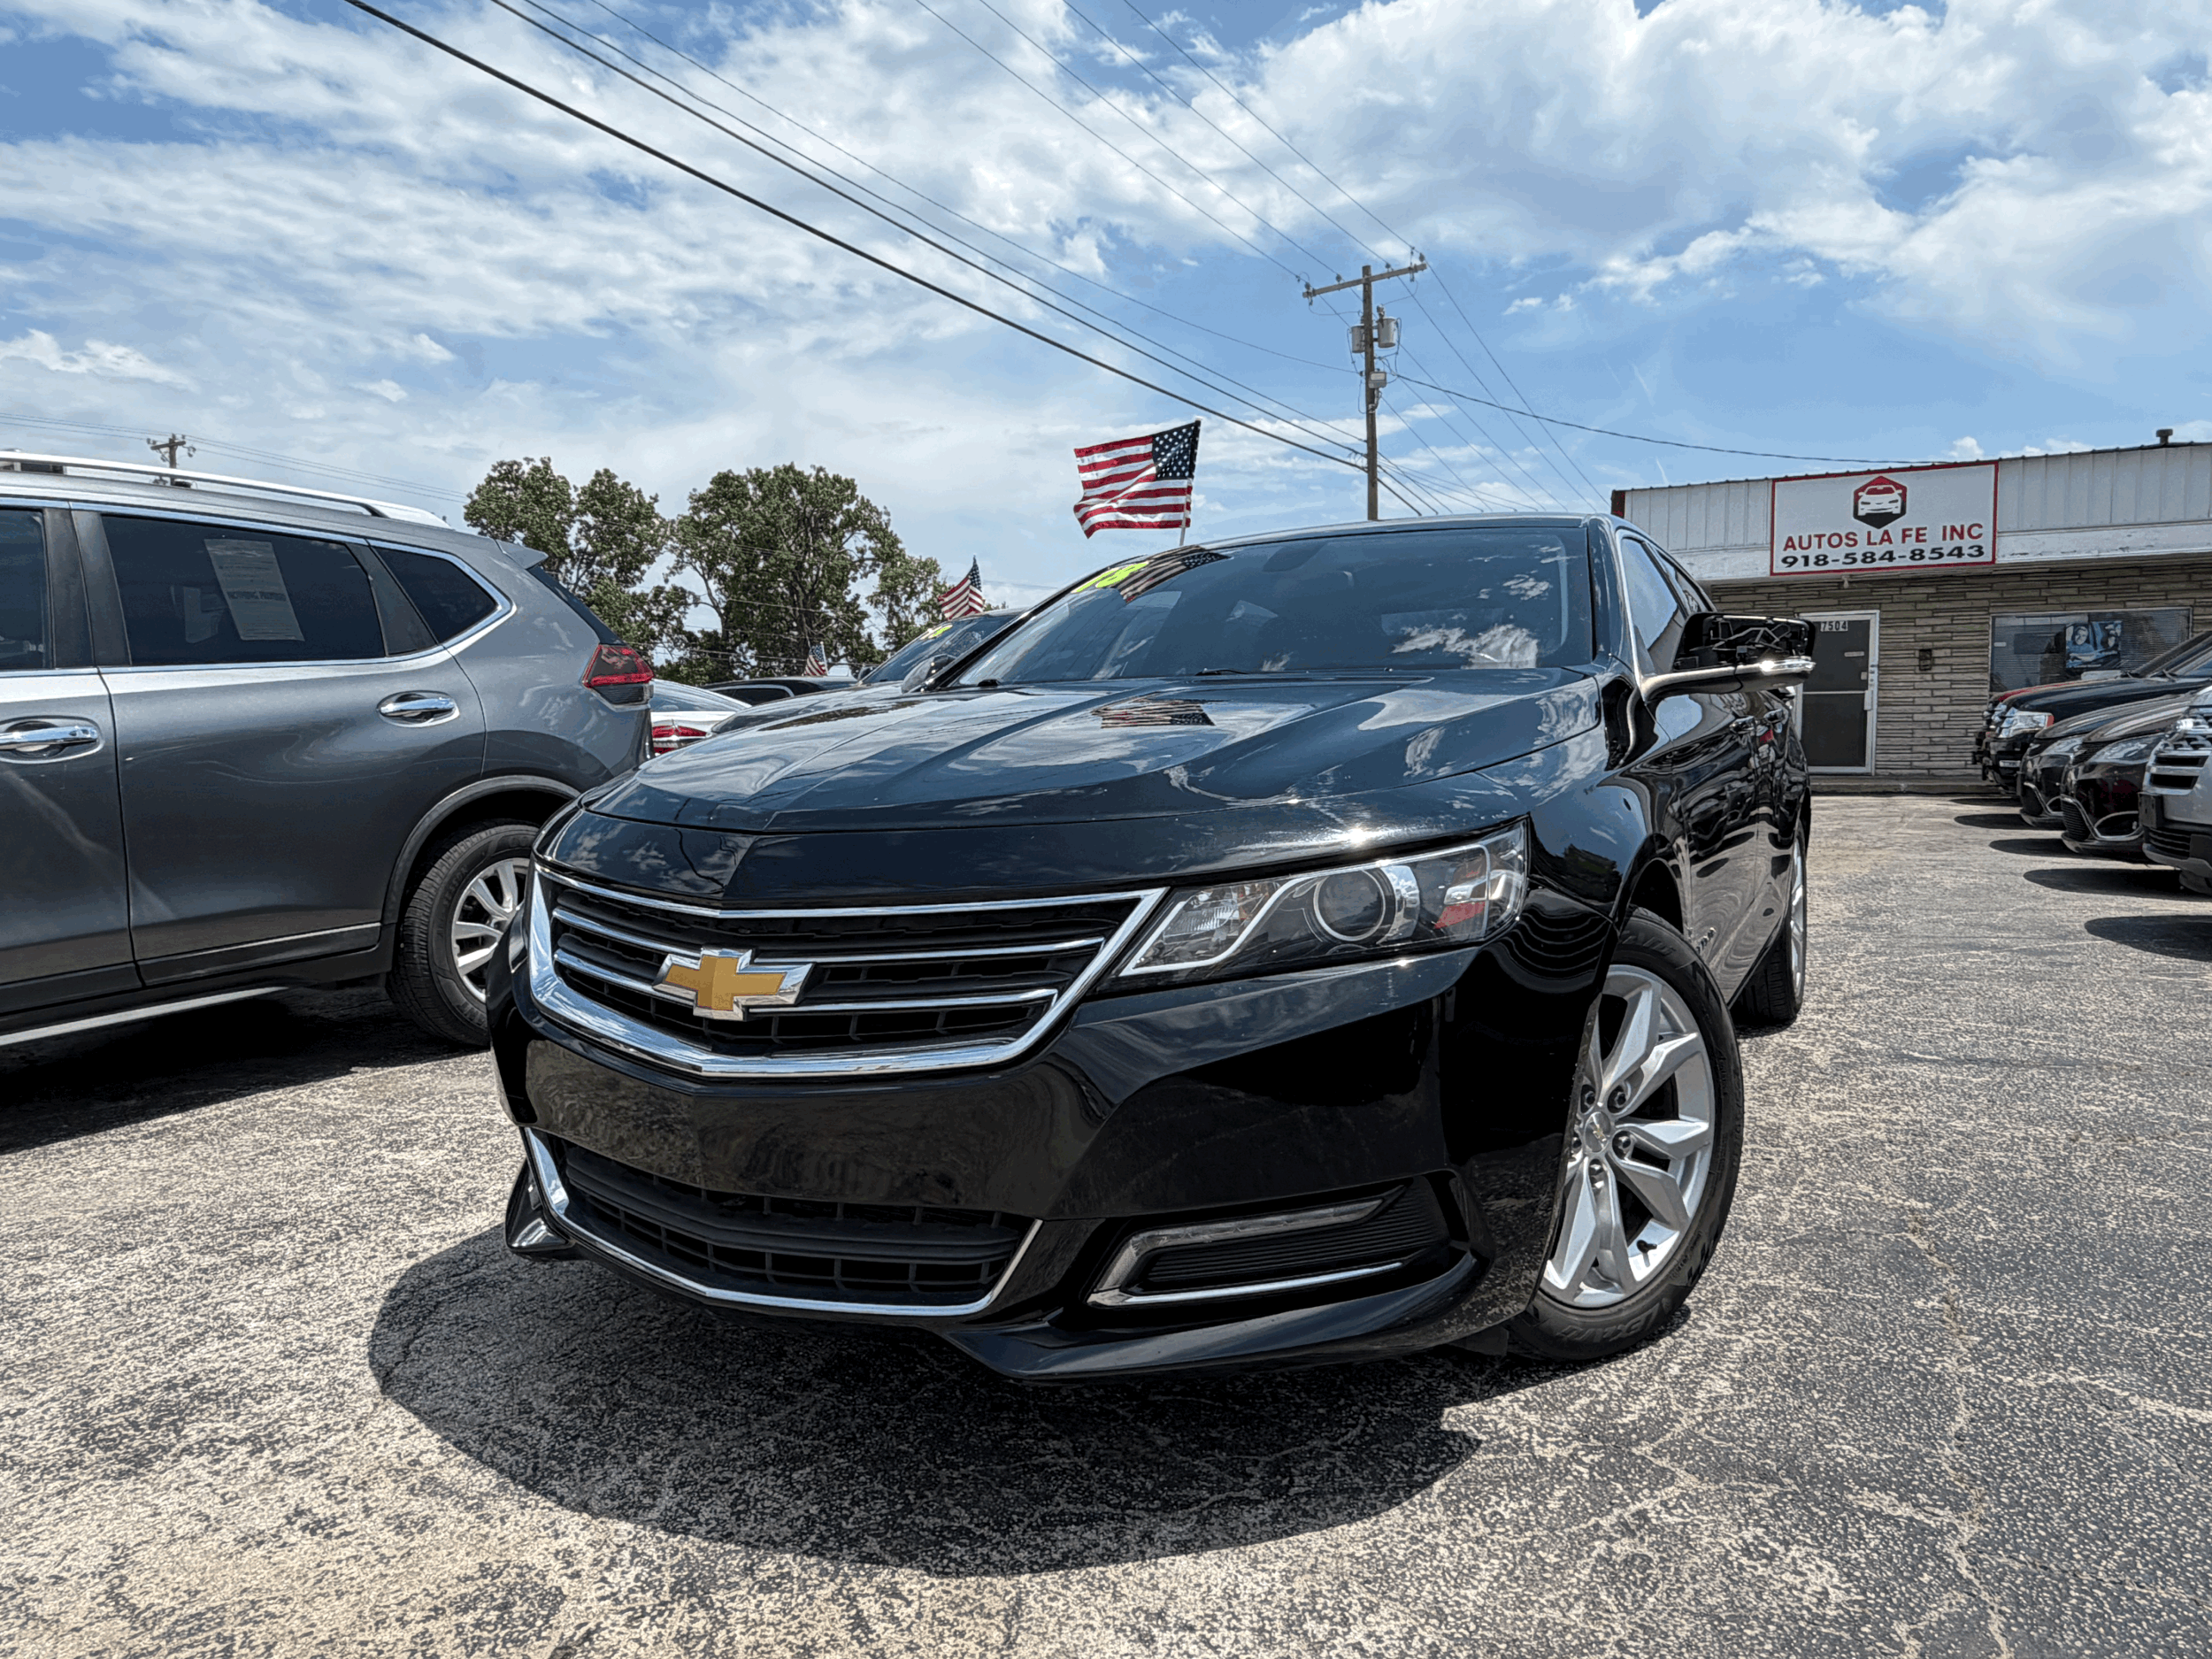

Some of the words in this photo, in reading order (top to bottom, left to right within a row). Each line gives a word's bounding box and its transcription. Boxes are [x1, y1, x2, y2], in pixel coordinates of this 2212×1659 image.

[1783, 532, 1858, 551] AUTOS
[1866, 530, 1893, 546] LA
[1901, 526, 1927, 544] FE
[1942, 523, 1984, 541] INC
[1781, 544, 1985, 568] 918-584-8543
[1821, 620, 1847, 631] 7504
